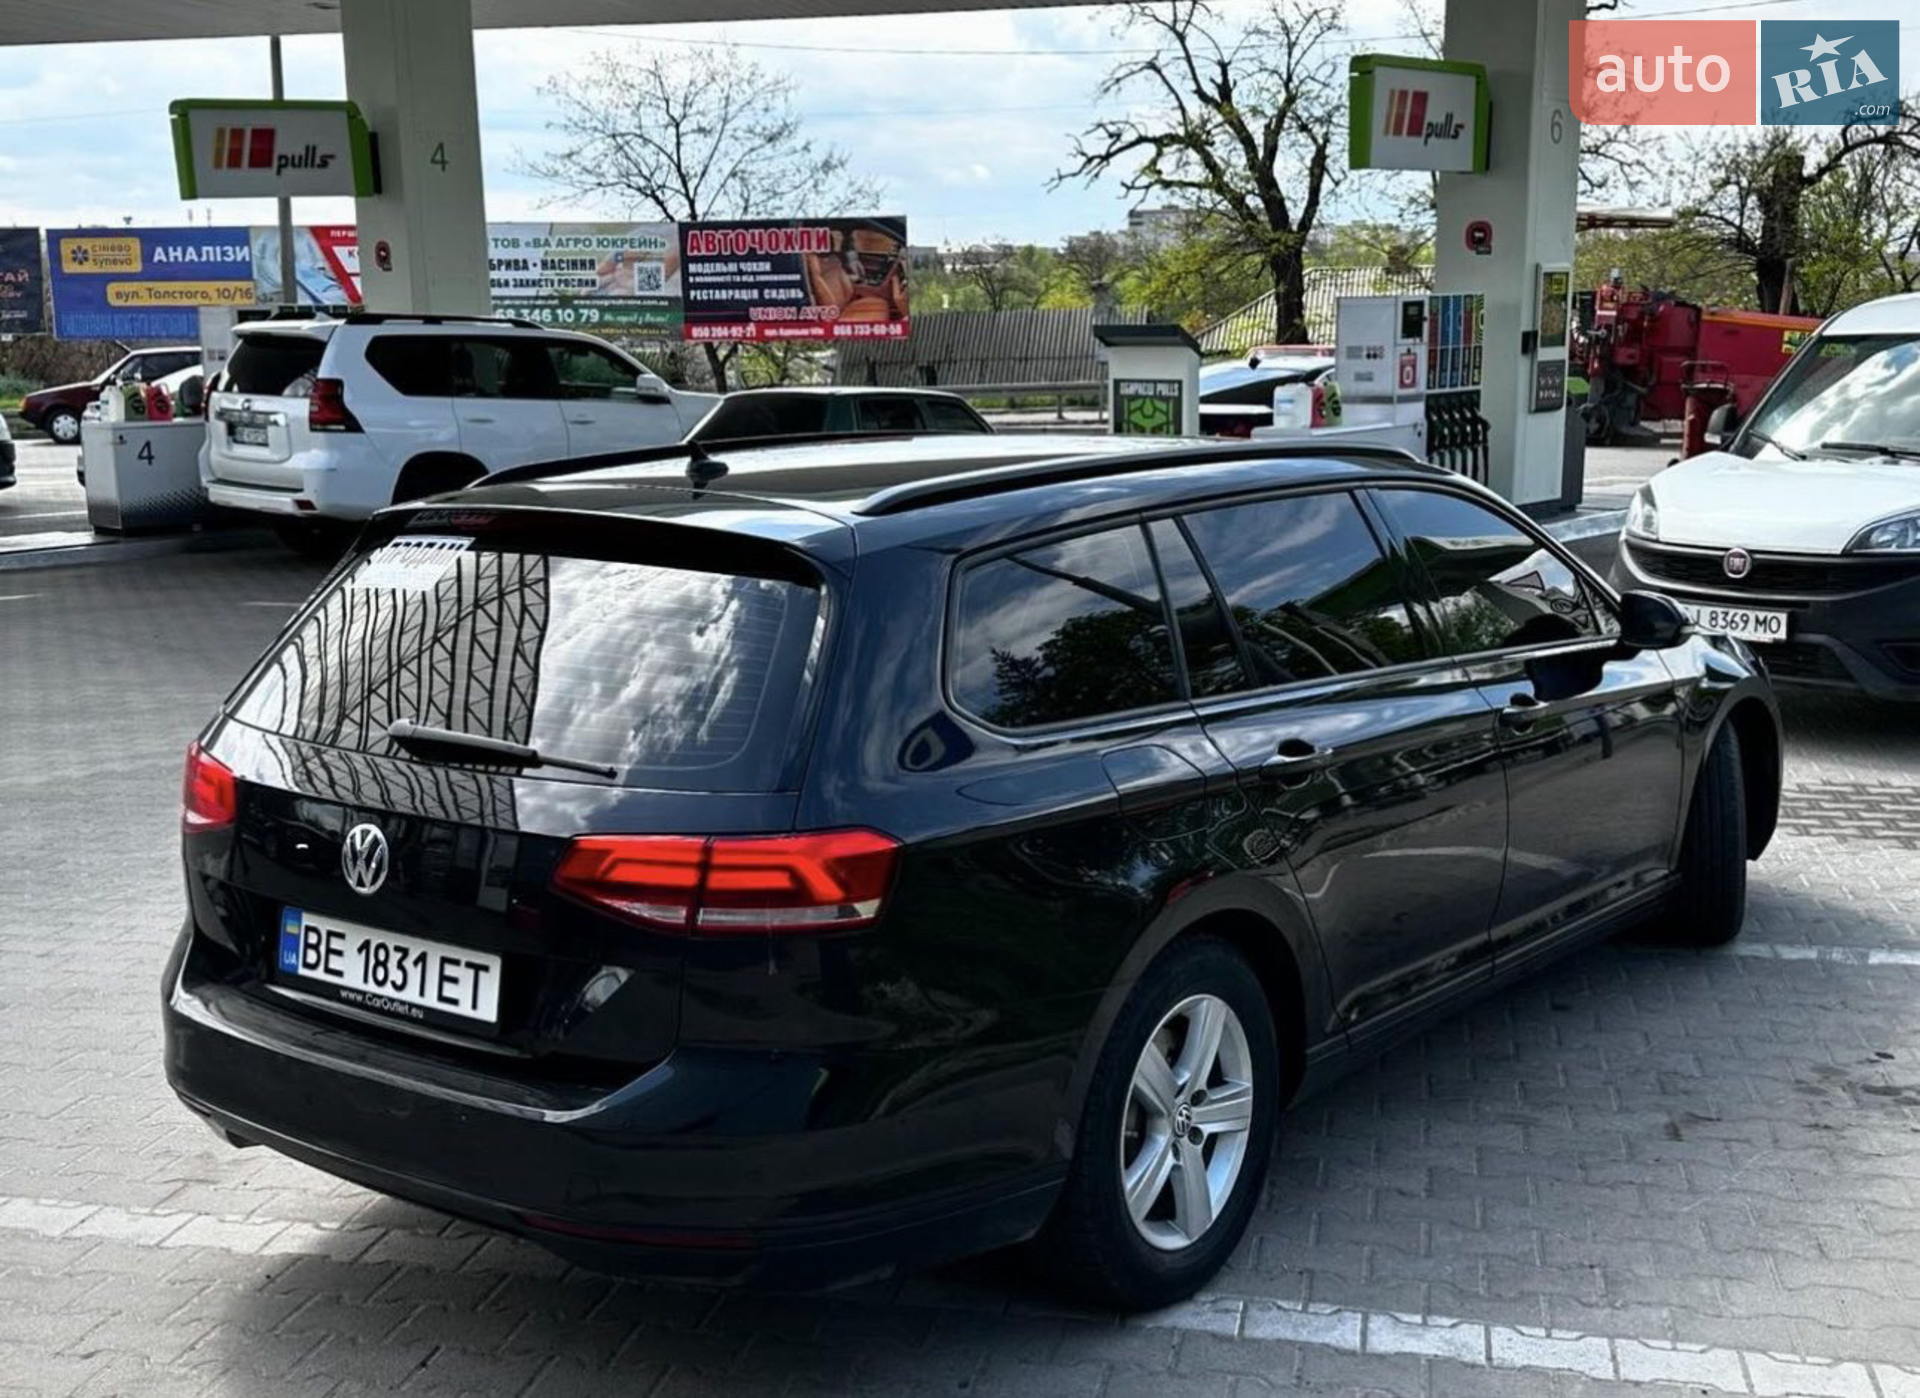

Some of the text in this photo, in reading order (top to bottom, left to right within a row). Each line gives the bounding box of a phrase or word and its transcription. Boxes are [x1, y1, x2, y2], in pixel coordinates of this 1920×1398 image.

[1424, 111, 1465, 147] pulls
[1550, 109, 1564, 144] 6
[276, 144, 336, 176] pulls
[430, 142, 449, 172] 4
[492, 235, 667, 249] ТОВ «ВА АГРО ЮКРЕЙН»
[687, 227, 832, 257] АВТОЧОХЛИ
[93, 256, 133, 267] synevo
[152, 245, 250, 263] АНАЛІЗИ
[540, 257, 596, 271] НАСІННЯ
[688, 261, 772, 274] МОДЕЛЬНІ ЧОХЛИ
[115, 286, 254, 303] вул. Толстого, 10/16
[689, 287, 805, 301] РЕСТАВРАЦІЯ СИДІНЬ
[520, 308, 553, 323] 346
[555, 308, 575, 323] 10
[578, 308, 600, 323] 79
[749, 304, 840, 321] UNION AVTO
[137, 440, 155, 466] 4
[1708, 610, 1750, 631] 8369
[1754, 613, 1782, 634] MO
[283, 952, 298, 966] UA
[301, 924, 491, 1011] BE 1831 ET
